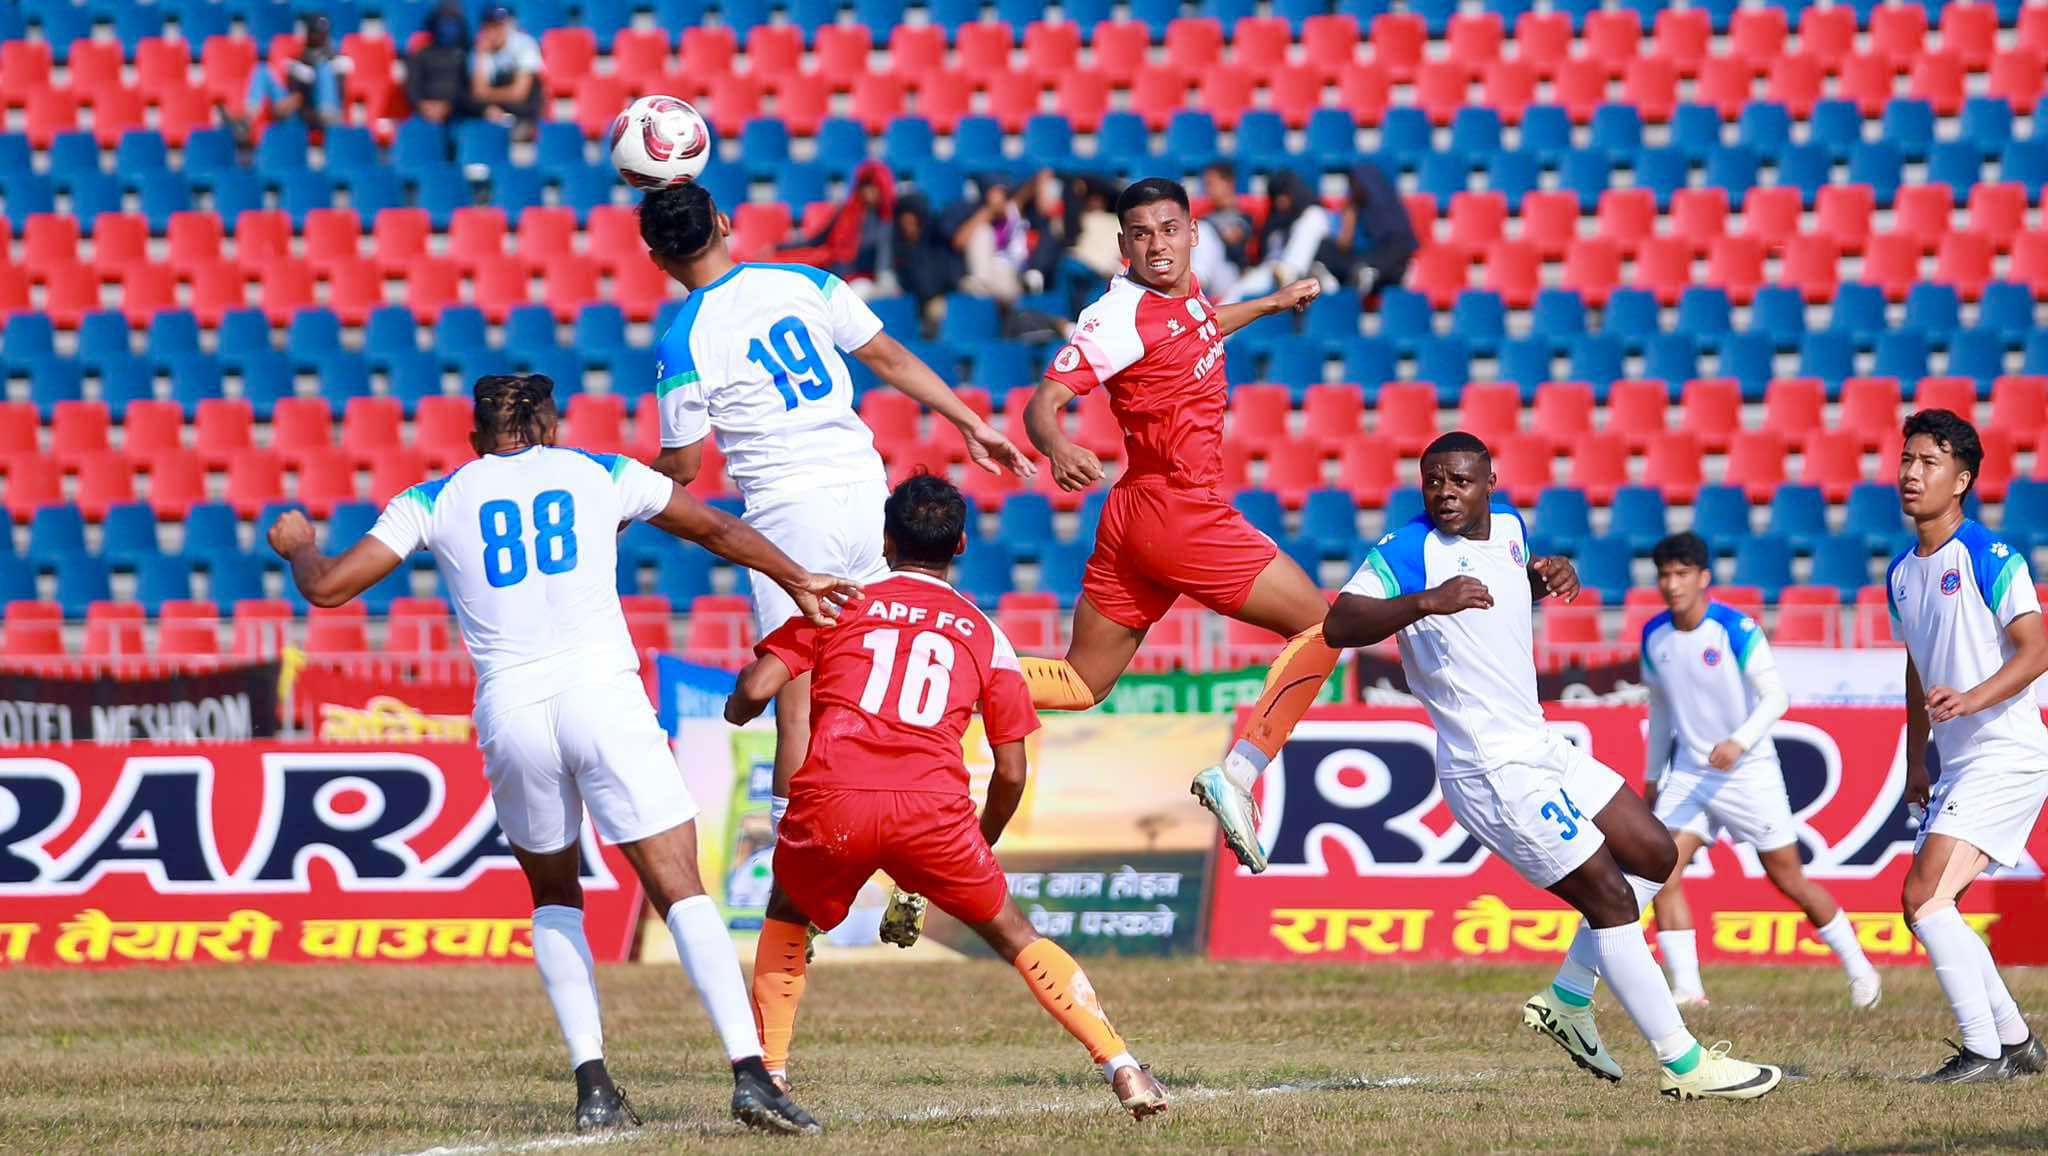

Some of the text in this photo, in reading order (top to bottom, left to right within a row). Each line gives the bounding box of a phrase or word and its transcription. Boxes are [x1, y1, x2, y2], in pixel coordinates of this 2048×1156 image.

[747, 315, 833, 411] 19
[479, 489, 578, 588] 88
[866, 600, 976, 637] APF FC
[858, 628, 955, 728] 16
[55, 909, 281, 962] तैयारी
[1270, 908, 1435, 954] रारा
